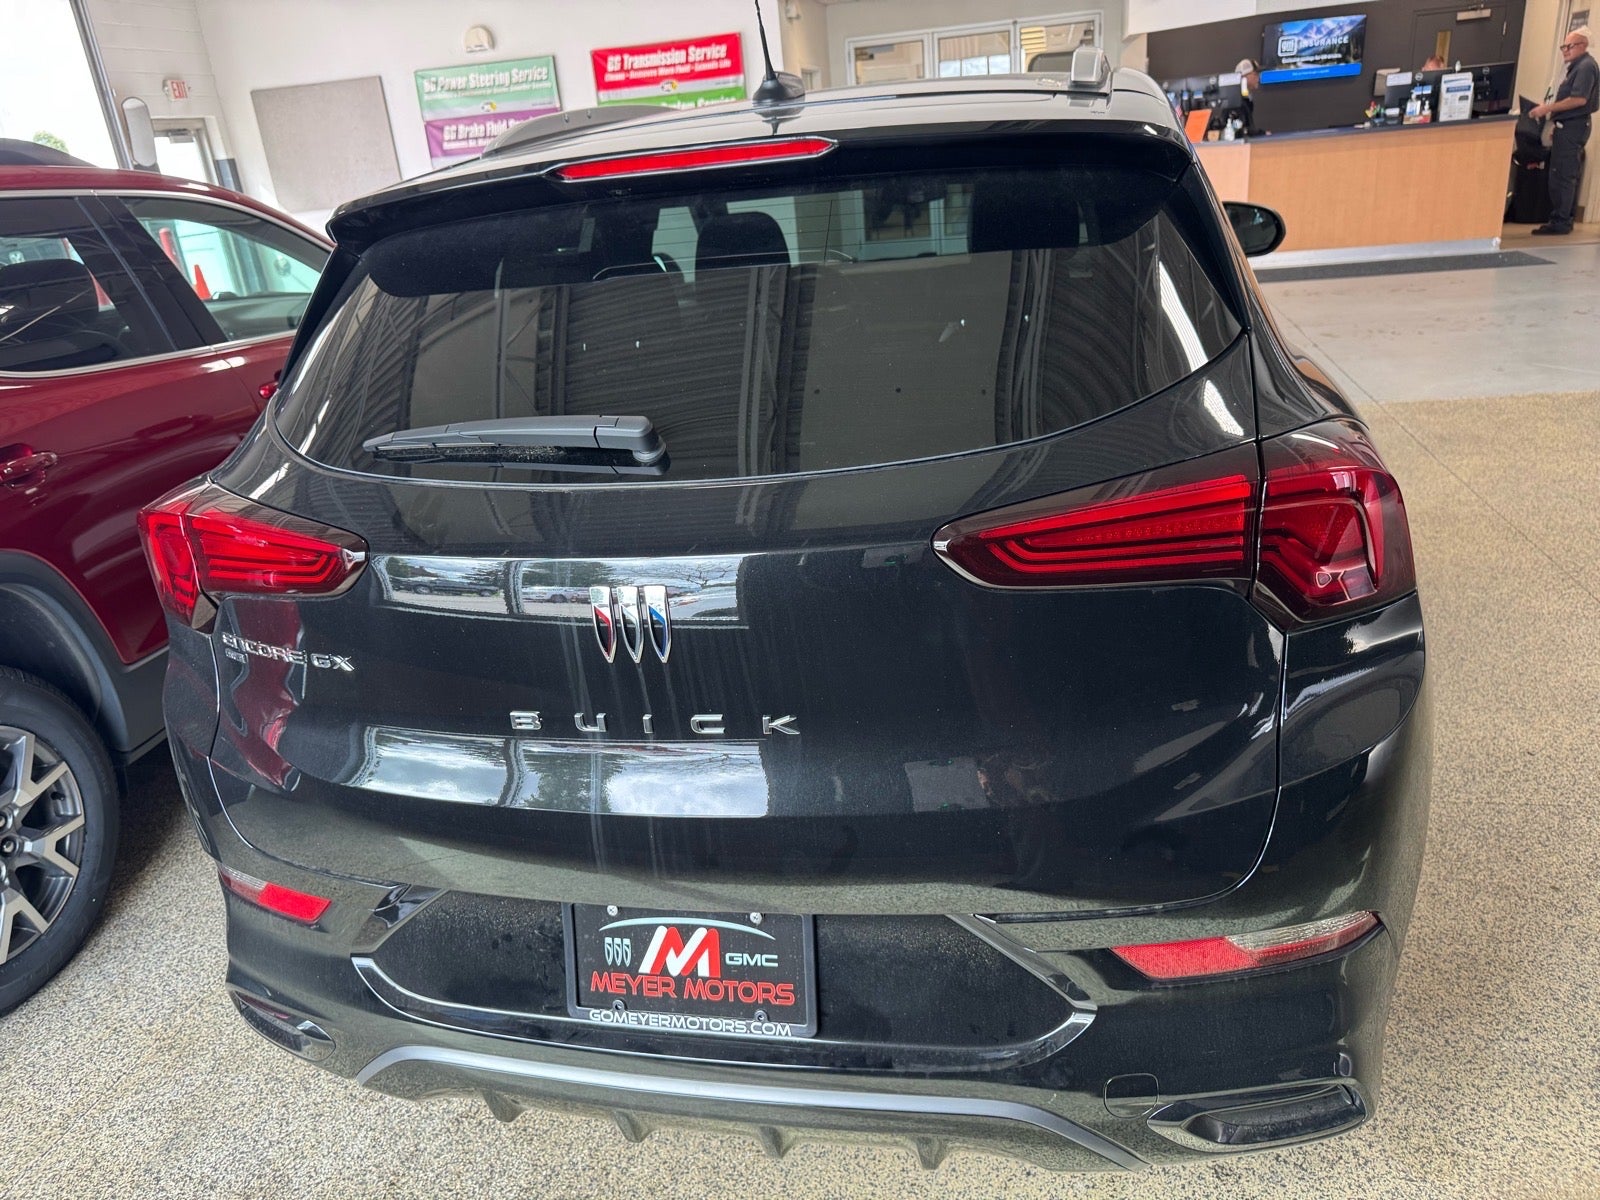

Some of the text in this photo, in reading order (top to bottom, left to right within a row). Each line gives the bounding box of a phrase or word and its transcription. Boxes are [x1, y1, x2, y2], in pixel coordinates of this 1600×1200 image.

[1299, 34, 1349, 49] INSURANCE
[622, 48, 688, 71] Transmission
[688, 44, 728, 64] Service
[171, 80, 188, 99] EXIT
[437, 74, 468, 91] Power
[468, 71, 511, 89] Steering
[511, 66, 549, 84] Service
[458, 123, 486, 140] Brake
[486, 121, 508, 138] Fluid
[222, 631, 306, 664] ENCORE
[310, 652, 355, 672] GX
[509, 710, 801, 735] BUICK
[725, 952, 778, 967] GMC
[590, 970, 795, 1006] MEYER MOTORS
[589, 1009, 792, 1037] GOMEYERMOTORS.COM
